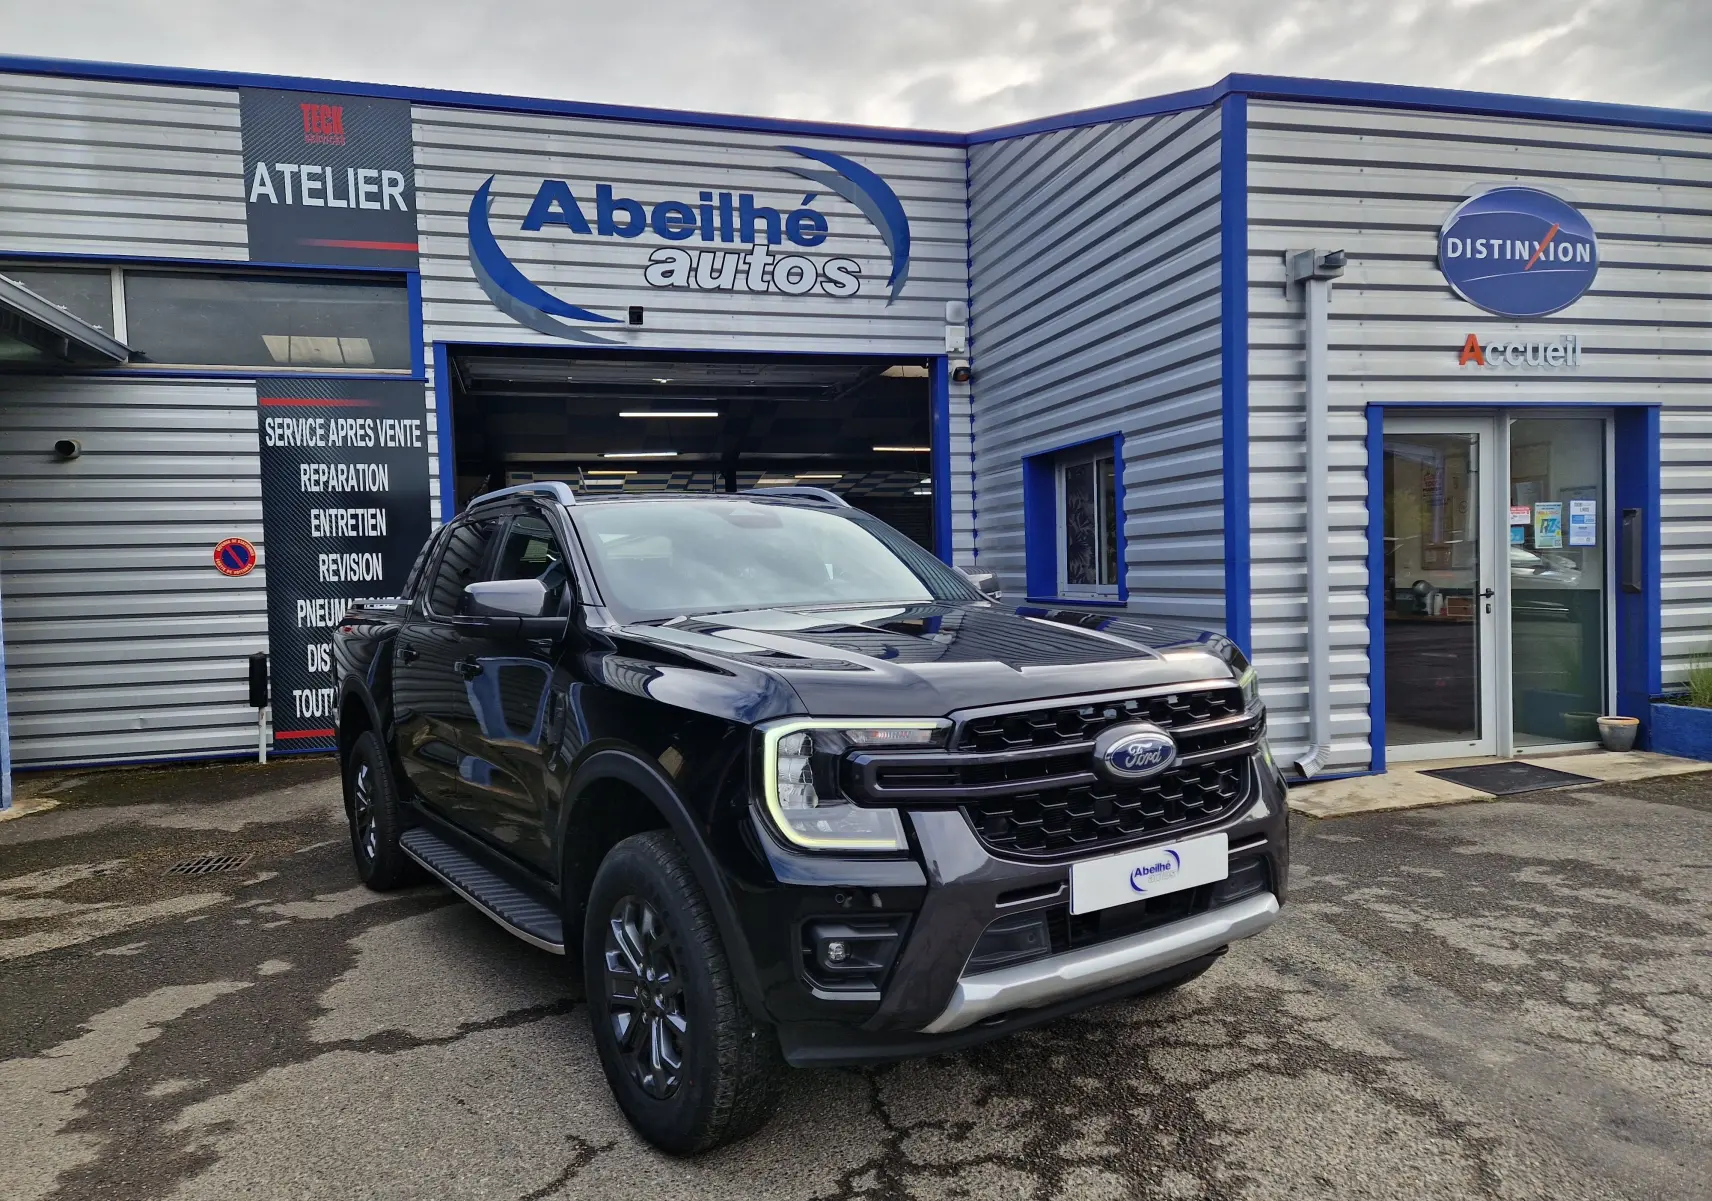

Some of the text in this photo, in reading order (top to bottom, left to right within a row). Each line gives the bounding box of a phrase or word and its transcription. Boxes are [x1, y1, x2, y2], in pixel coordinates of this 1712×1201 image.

[301, 103, 344, 135] TECK
[250, 161, 408, 212] ATELIER
[520, 179, 829, 247] Abeilhé
[1447, 231, 1590, 267] DISTINXION
[644, 244, 862, 297] autos
[1459, 333, 1582, 367] Accueil
[265, 417, 422, 448] SERVICE APRES VENTE
[300, 463, 389, 492] REPARATION
[310, 508, 387, 537] ENTRETIEN
[319, 552, 383, 582] REVISION
[307, 643, 333, 673] DIS
[293, 688, 335, 718] TOUT
[1125, 742, 1163, 768] Ford
[1134, 860, 1171, 878] Abeilhé
